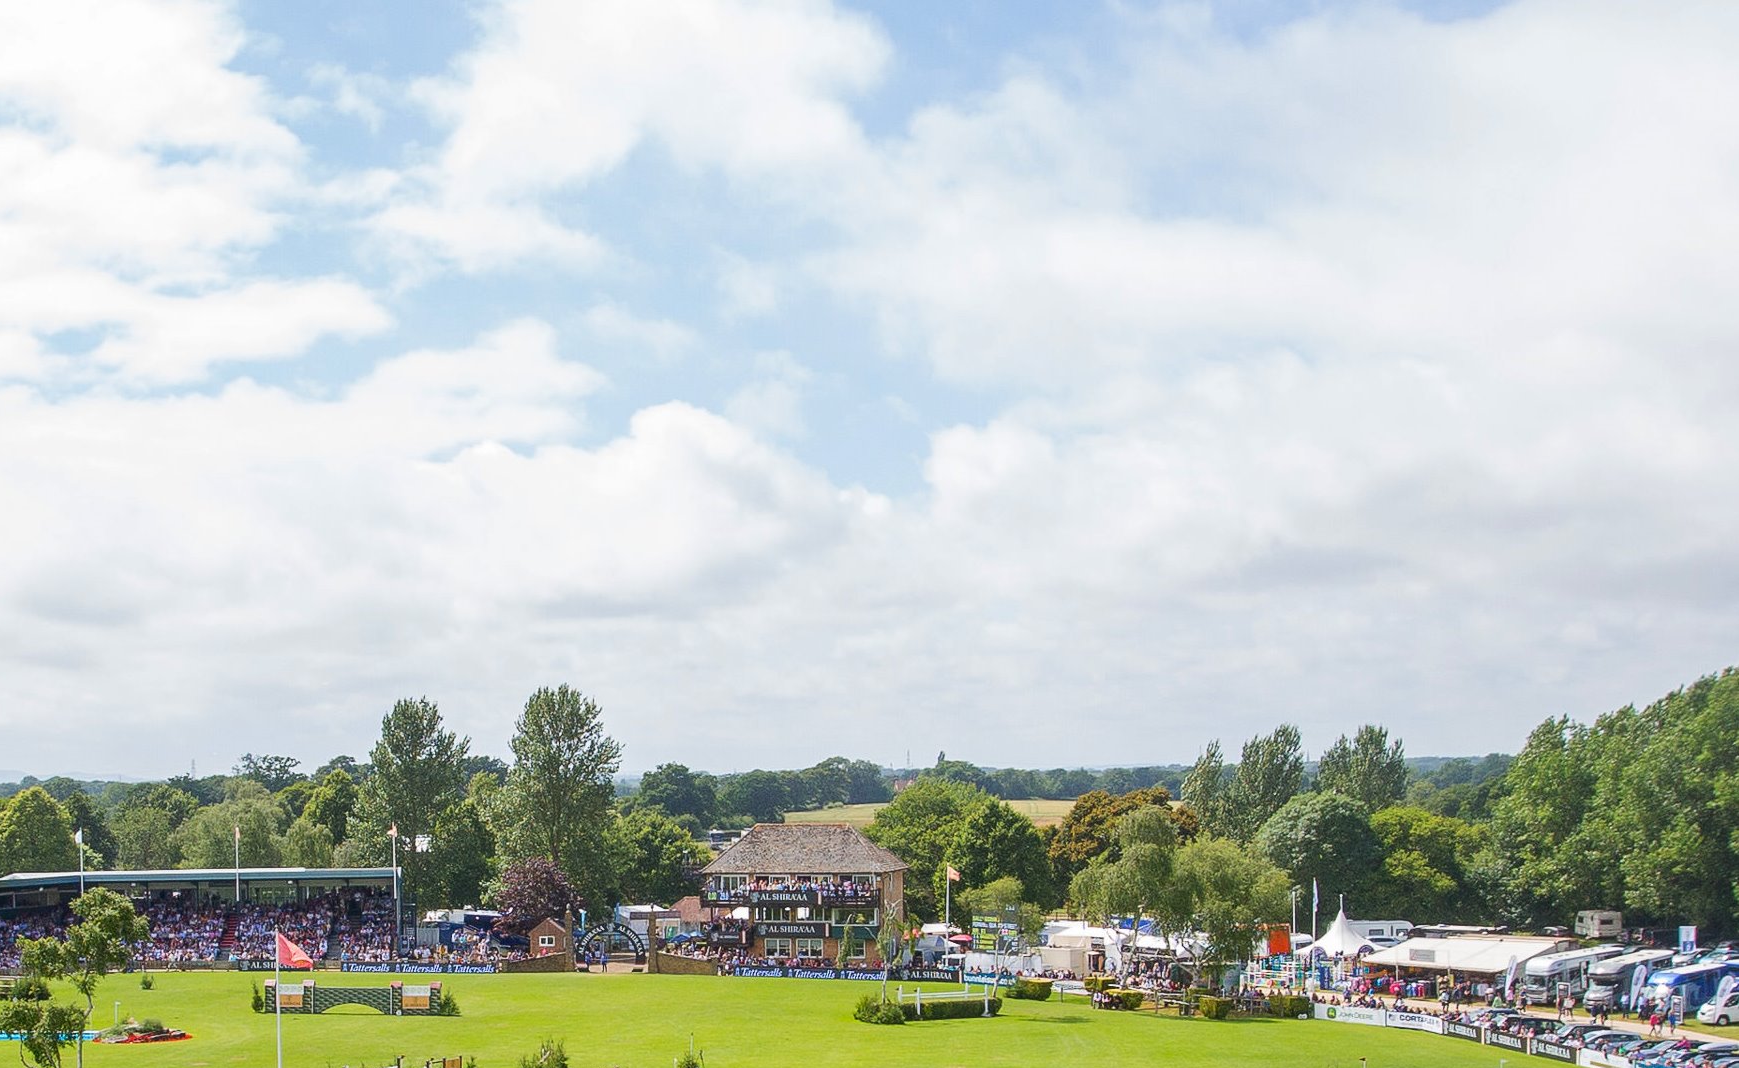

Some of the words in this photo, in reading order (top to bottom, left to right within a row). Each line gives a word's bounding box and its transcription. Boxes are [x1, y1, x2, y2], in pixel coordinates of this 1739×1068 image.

[760, 893, 771, 901] AL
[768, 925, 779, 933] AL
[250, 961, 262, 969] AL
[348, 963, 390, 972] Tattersalls
[401, 964, 443, 973] Tattersalls
[453, 964, 494, 973] Tattersalls
[741, 967, 783, 977] Tattersalls
[793, 968, 836, 979] Tattersalls
[846, 970, 886, 980] Tattersall
